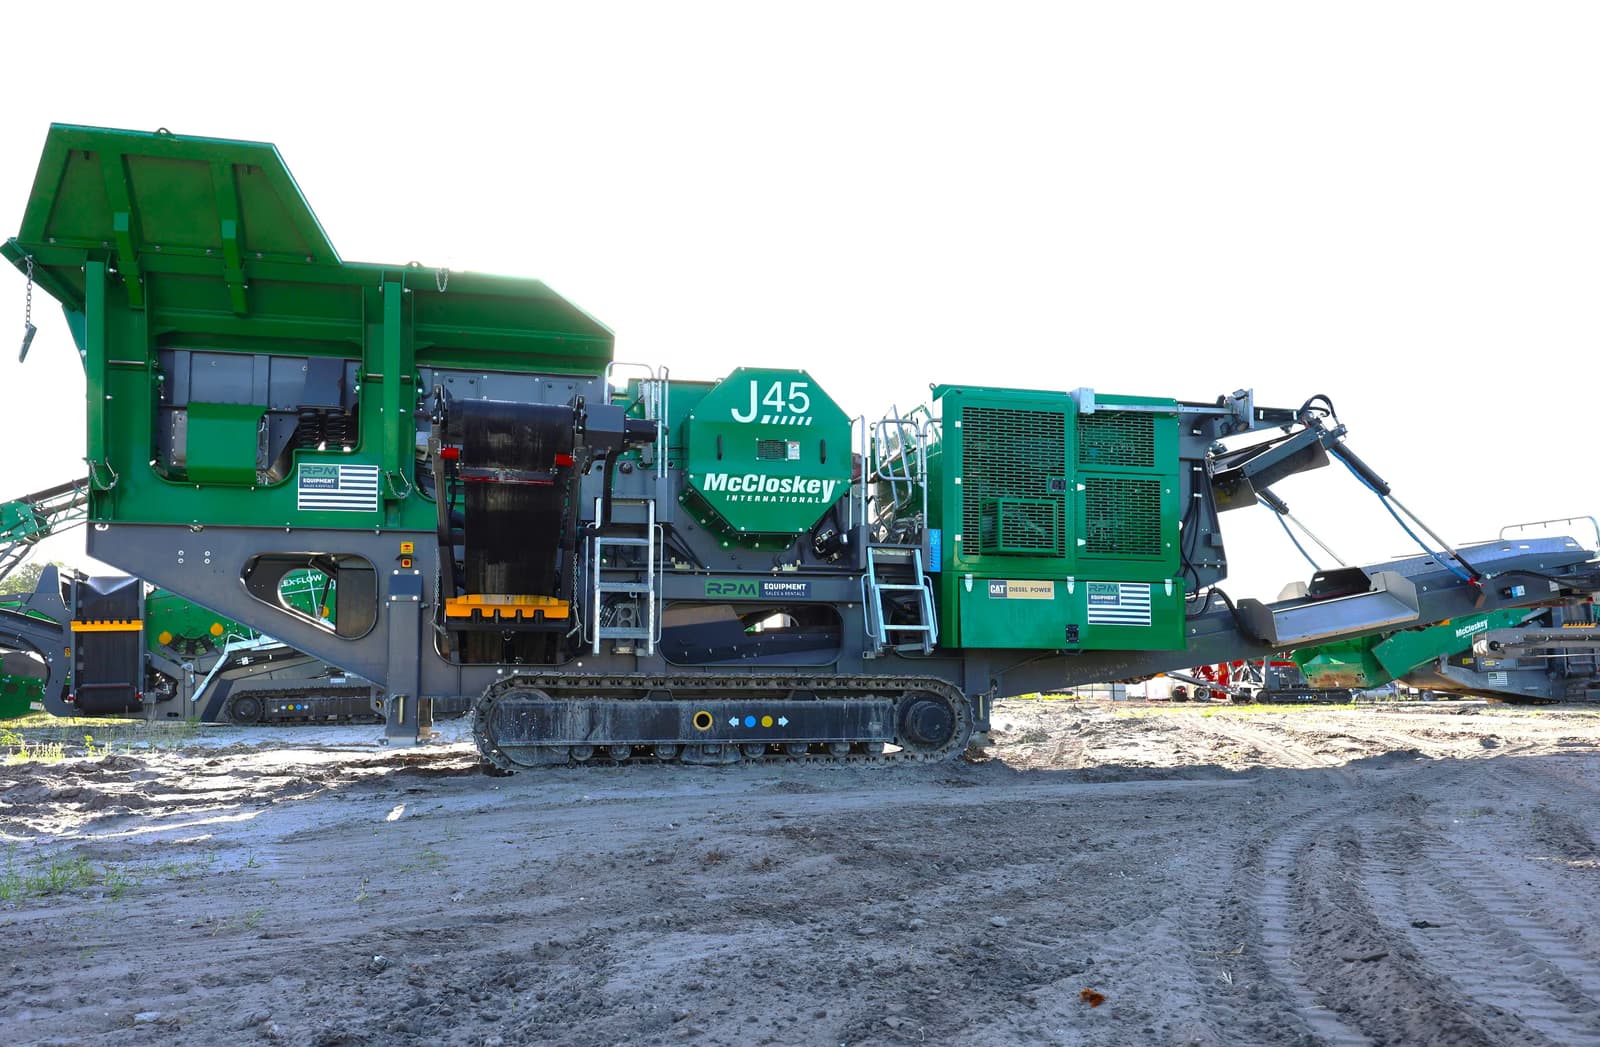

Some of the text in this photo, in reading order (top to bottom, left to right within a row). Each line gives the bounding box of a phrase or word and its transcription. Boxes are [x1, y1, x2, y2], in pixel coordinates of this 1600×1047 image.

[731, 380, 810, 423] J45
[301, 466, 338, 476] RPM
[703, 473, 835, 503] McCloskey
[726, 494, 820, 504] INTERNATIONAL
[706, 582, 757, 595] RPM
[990, 584, 1006, 594] CAT
[1088, 584, 1118, 593] RPM
[1455, 619, 1488, 638] McCloskey
